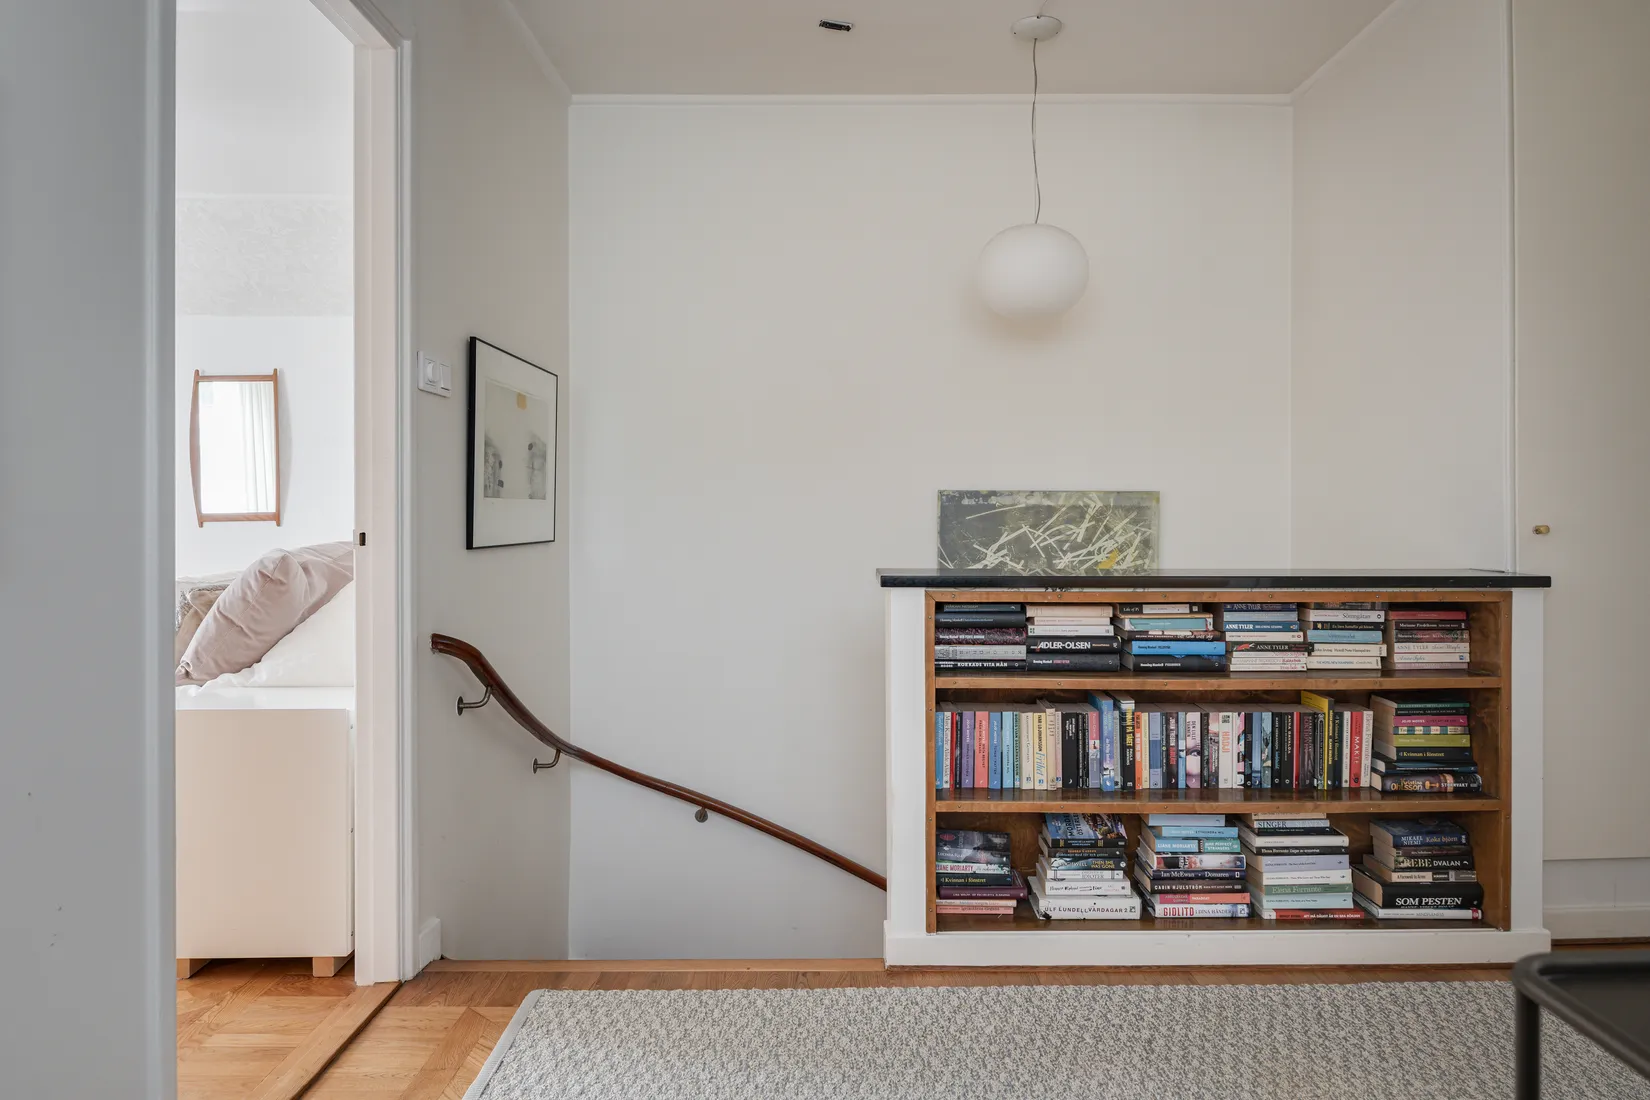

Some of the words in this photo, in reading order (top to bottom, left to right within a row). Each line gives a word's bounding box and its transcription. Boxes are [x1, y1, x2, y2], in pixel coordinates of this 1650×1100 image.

[1038, 641, 1091, 649] ADLER-OLSEN
[1222, 731, 1230, 753] HADJI
[1036, 752, 1045, 776] Frihet
[1395, 897, 1419, 906] SOM
[1421, 897, 1462, 906] PESTEN
[1163, 907, 1194, 916] GIOLITO
